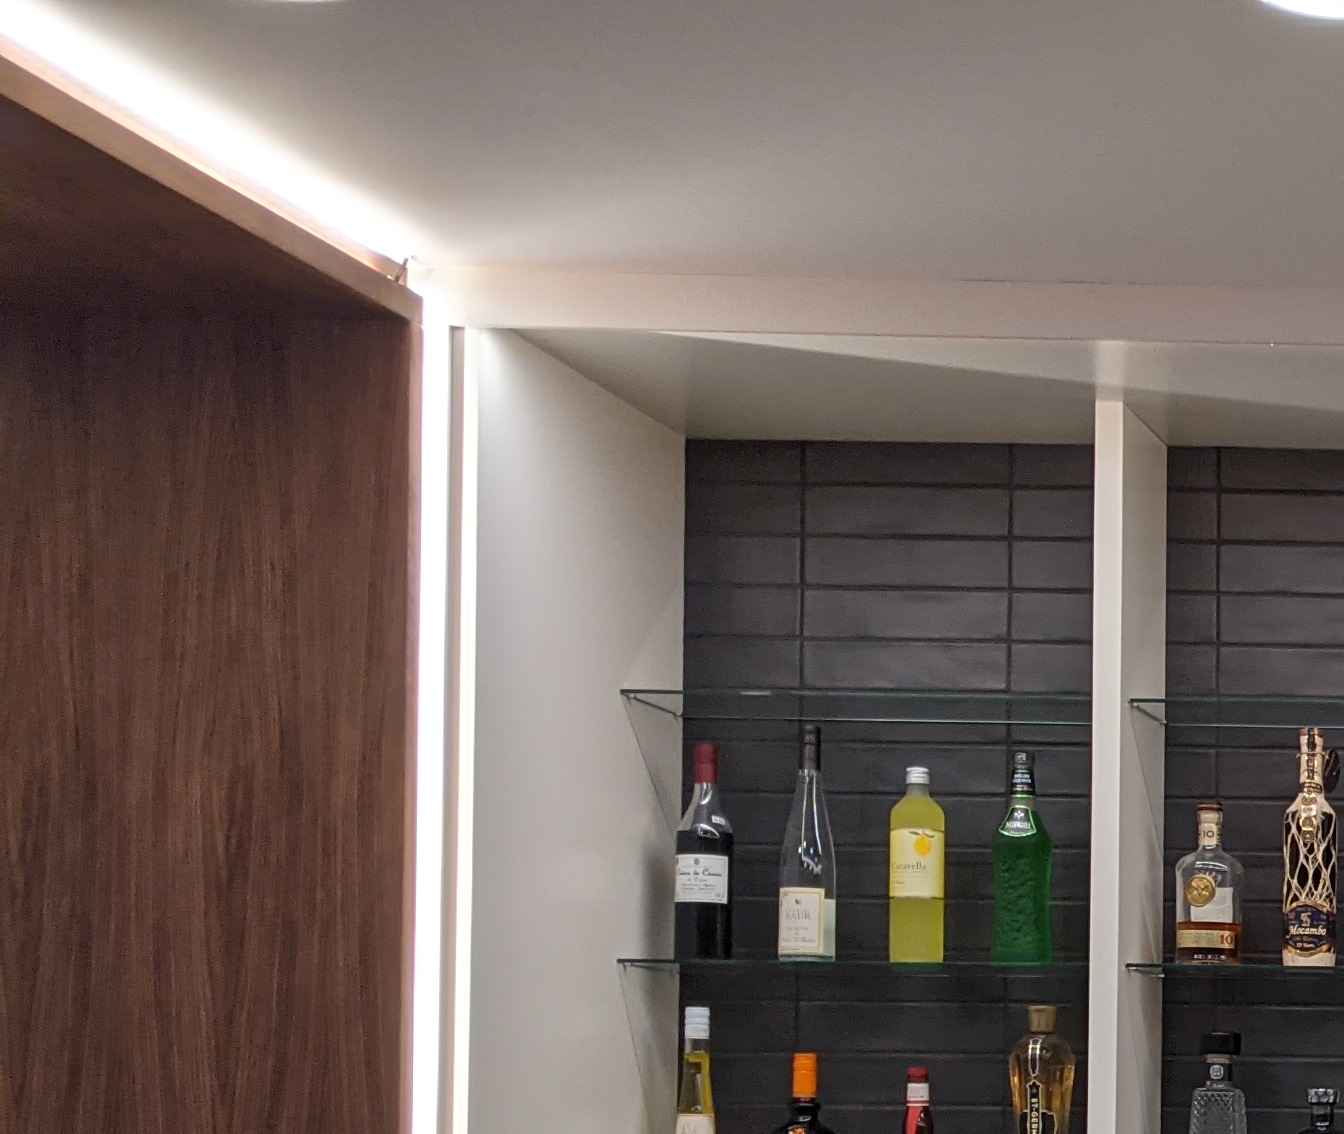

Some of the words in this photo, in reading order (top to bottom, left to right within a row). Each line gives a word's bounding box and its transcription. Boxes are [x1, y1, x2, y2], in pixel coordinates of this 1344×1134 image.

[891, 861, 927, 870] Caravella
[1286, 924, 1327, 938] Mocambo
[1219, 934, 1234, 945] 10
